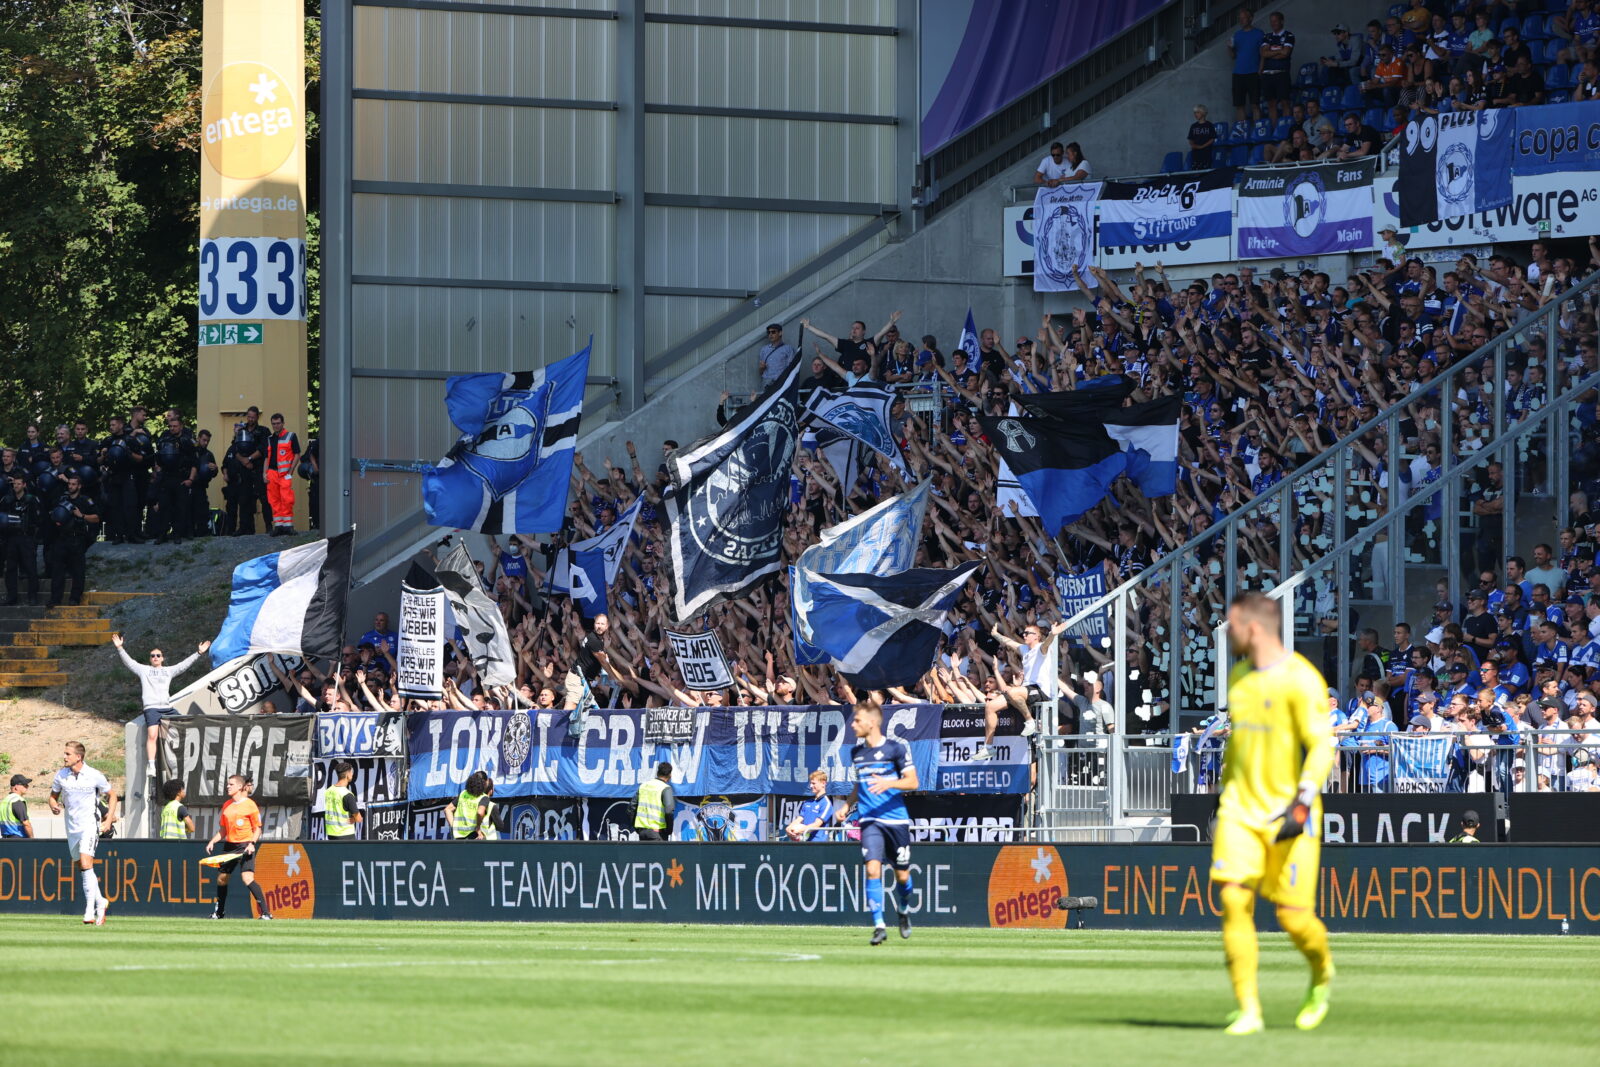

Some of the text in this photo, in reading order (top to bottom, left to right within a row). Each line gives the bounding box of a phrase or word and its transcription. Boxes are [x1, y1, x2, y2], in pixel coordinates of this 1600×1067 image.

[206, 106, 293, 144] entega
[1405, 116, 1438, 156] 90
[1440, 111, 1476, 131] PLUS
[1519, 125, 1580, 161] copa
[1244, 169, 1363, 190] Arminia Fans
[214, 194, 298, 212] entega.de
[1179, 182, 1199, 211] 6
[1580, 189, 1597, 201] AG
[1248, 228, 1362, 249] Rhein- Main
[419, 607, 436, 620] WIR
[417, 657, 436, 671] WIR
[682, 661, 718, 683] 1905
[398, 670, 435, 686] HASSEN
[679, 708, 693, 721] ALS
[943, 718, 965, 728] BLOCK
[965, 718, 970, 727] 6
[320, 717, 376, 755] BOYS
[662, 721, 692, 734] AUFLAGE
[426, 714, 559, 786] LOKL
[735, 707, 918, 783] ULTRS
[943, 741, 1011, 762] The Frm
[162, 725, 287, 797] SPENGE
[942, 771, 1012, 789] BIELEFELD
[1324, 812, 1450, 843] BLACK
[0, 858, 75, 902] DLICH
[342, 861, 449, 907] ENTEGA
[484, 860, 668, 909] TEAMPLAYER
[696, 862, 746, 911] MIT
[994, 885, 1062, 925] entega
